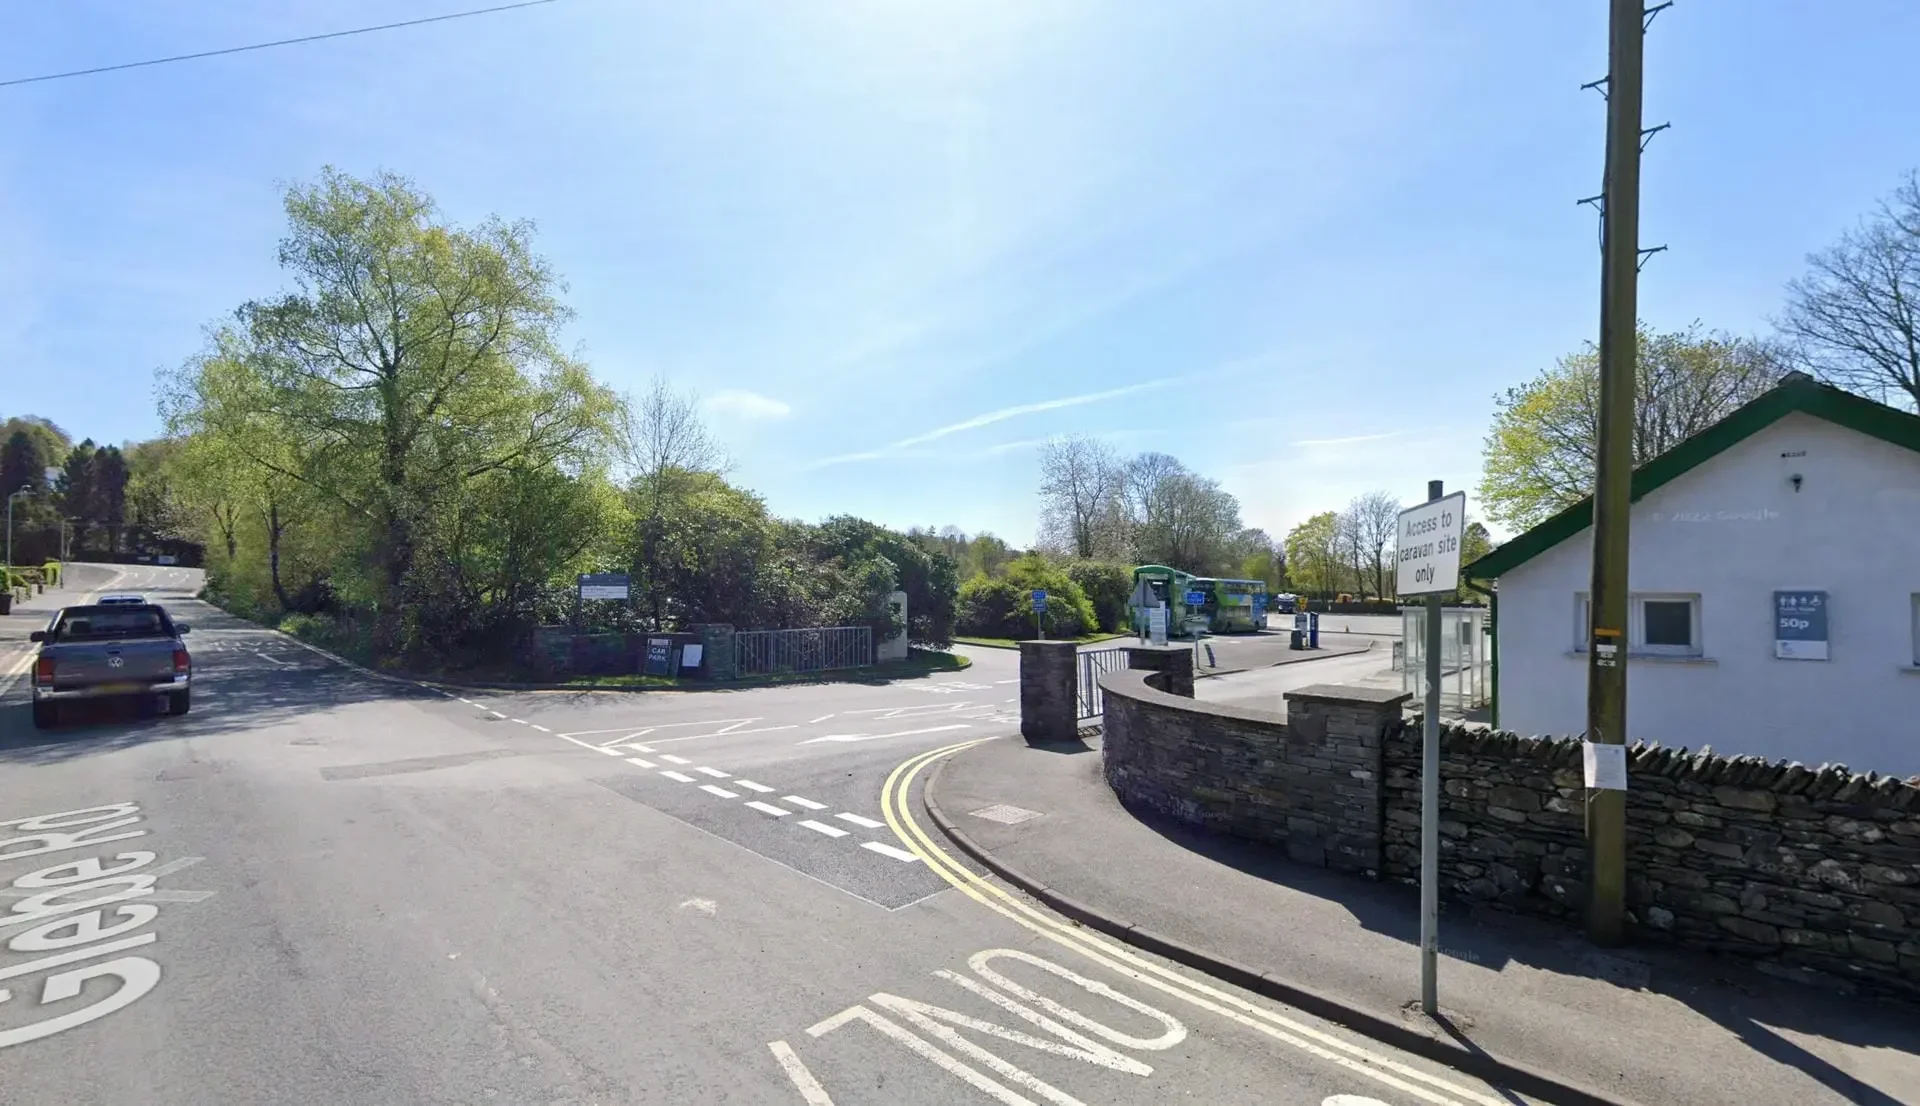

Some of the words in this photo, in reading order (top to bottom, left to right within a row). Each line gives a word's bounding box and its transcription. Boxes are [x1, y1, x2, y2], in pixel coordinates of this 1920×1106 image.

[1405, 516, 1437, 538] Access
[1441, 510, 1452, 529] to
[1400, 542, 1434, 562] caravan
[1438, 534, 1457, 555] site
[1415, 563, 1435, 584] only
[1780, 618, 1810, 630] 50p
[648, 653, 667, 662] PARK
